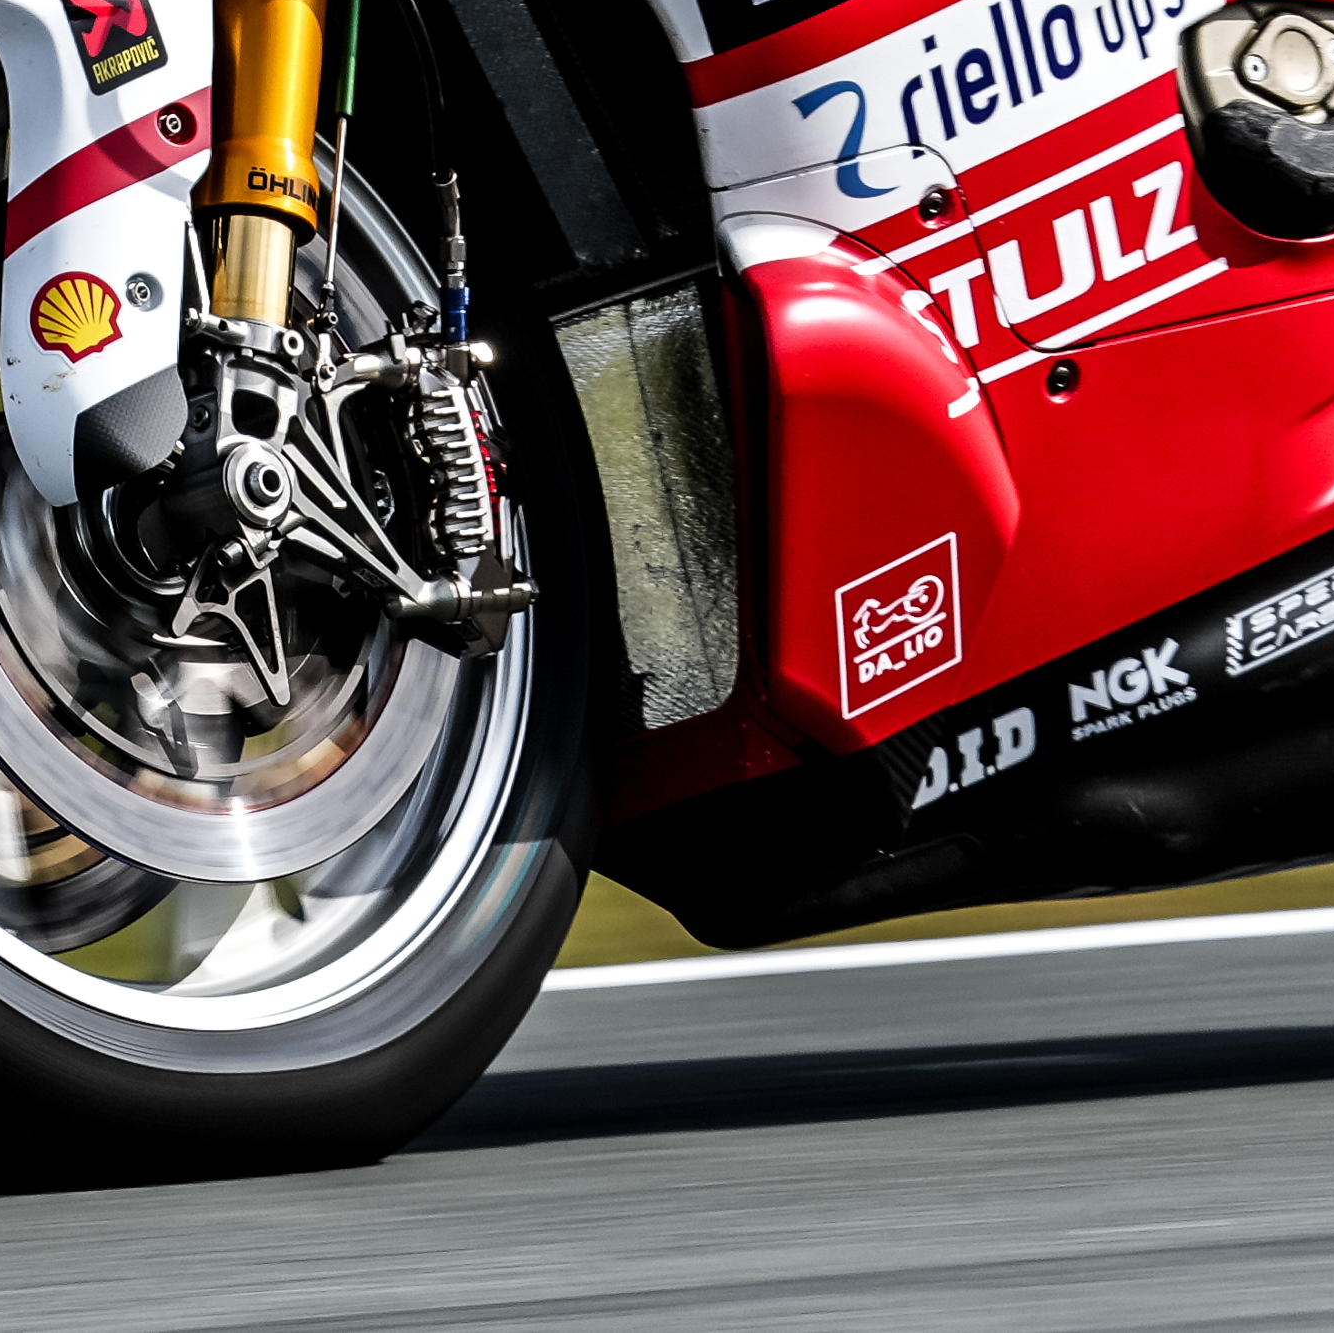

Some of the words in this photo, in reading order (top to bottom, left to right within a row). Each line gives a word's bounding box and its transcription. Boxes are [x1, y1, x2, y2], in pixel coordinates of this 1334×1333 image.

[92, 35, 160, 84] AKRAPOVIČ
[1068, 637, 1191, 722] NGK
[1071, 710, 1134, 741] SPARK
[1137, 686, 1199, 721] PLUGS
